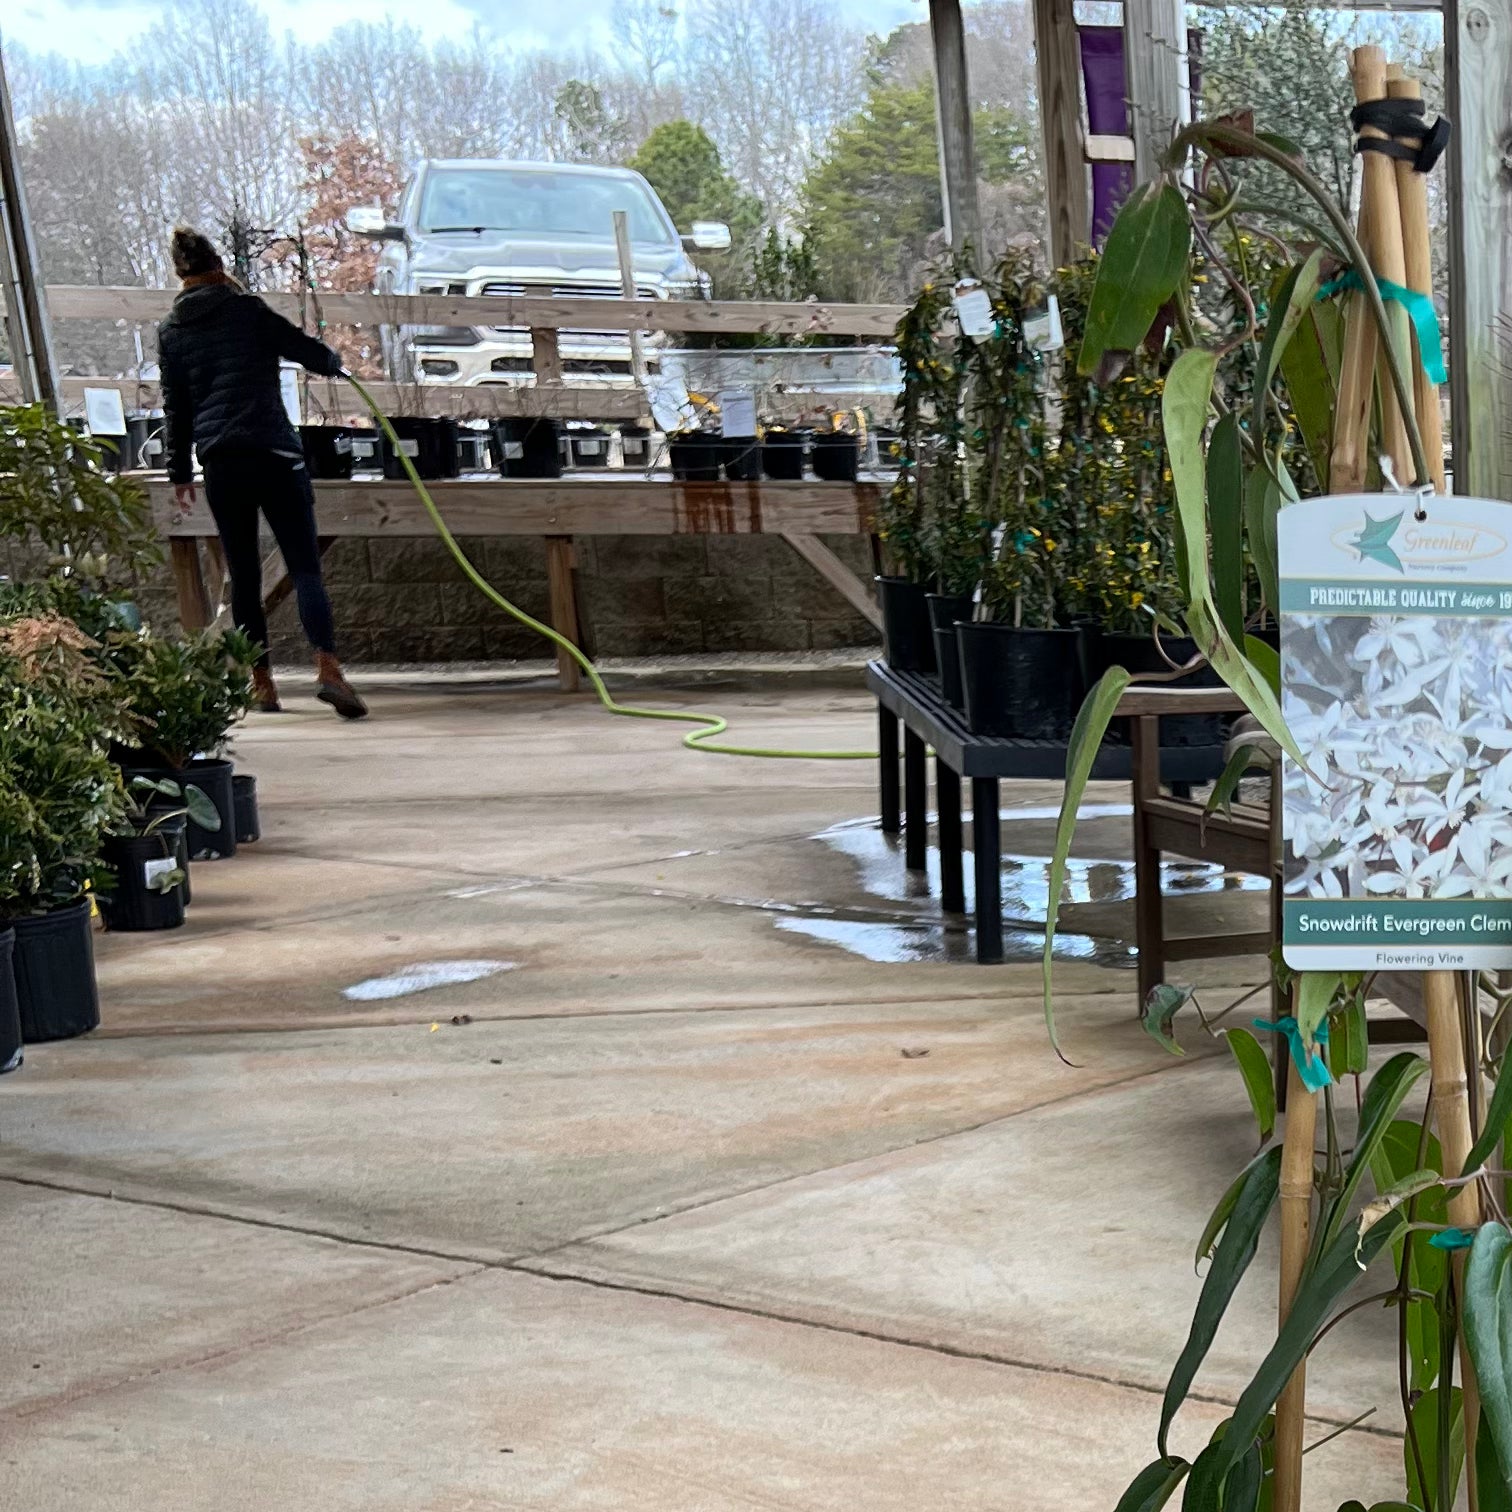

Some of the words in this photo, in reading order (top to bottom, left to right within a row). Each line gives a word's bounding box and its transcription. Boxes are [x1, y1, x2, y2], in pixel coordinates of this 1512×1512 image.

[1404, 528, 1478, 553] Greenleaf
[1310, 587, 1397, 607] PREDICTABLE
[1401, 590, 1456, 609] QUALITY
[1299, 914, 1378, 933] Snowdrift
[1383, 915, 1466, 936] Evergreen
[1376, 953, 1434, 967] Flowering
[1438, 953, 1464, 964] Vine
